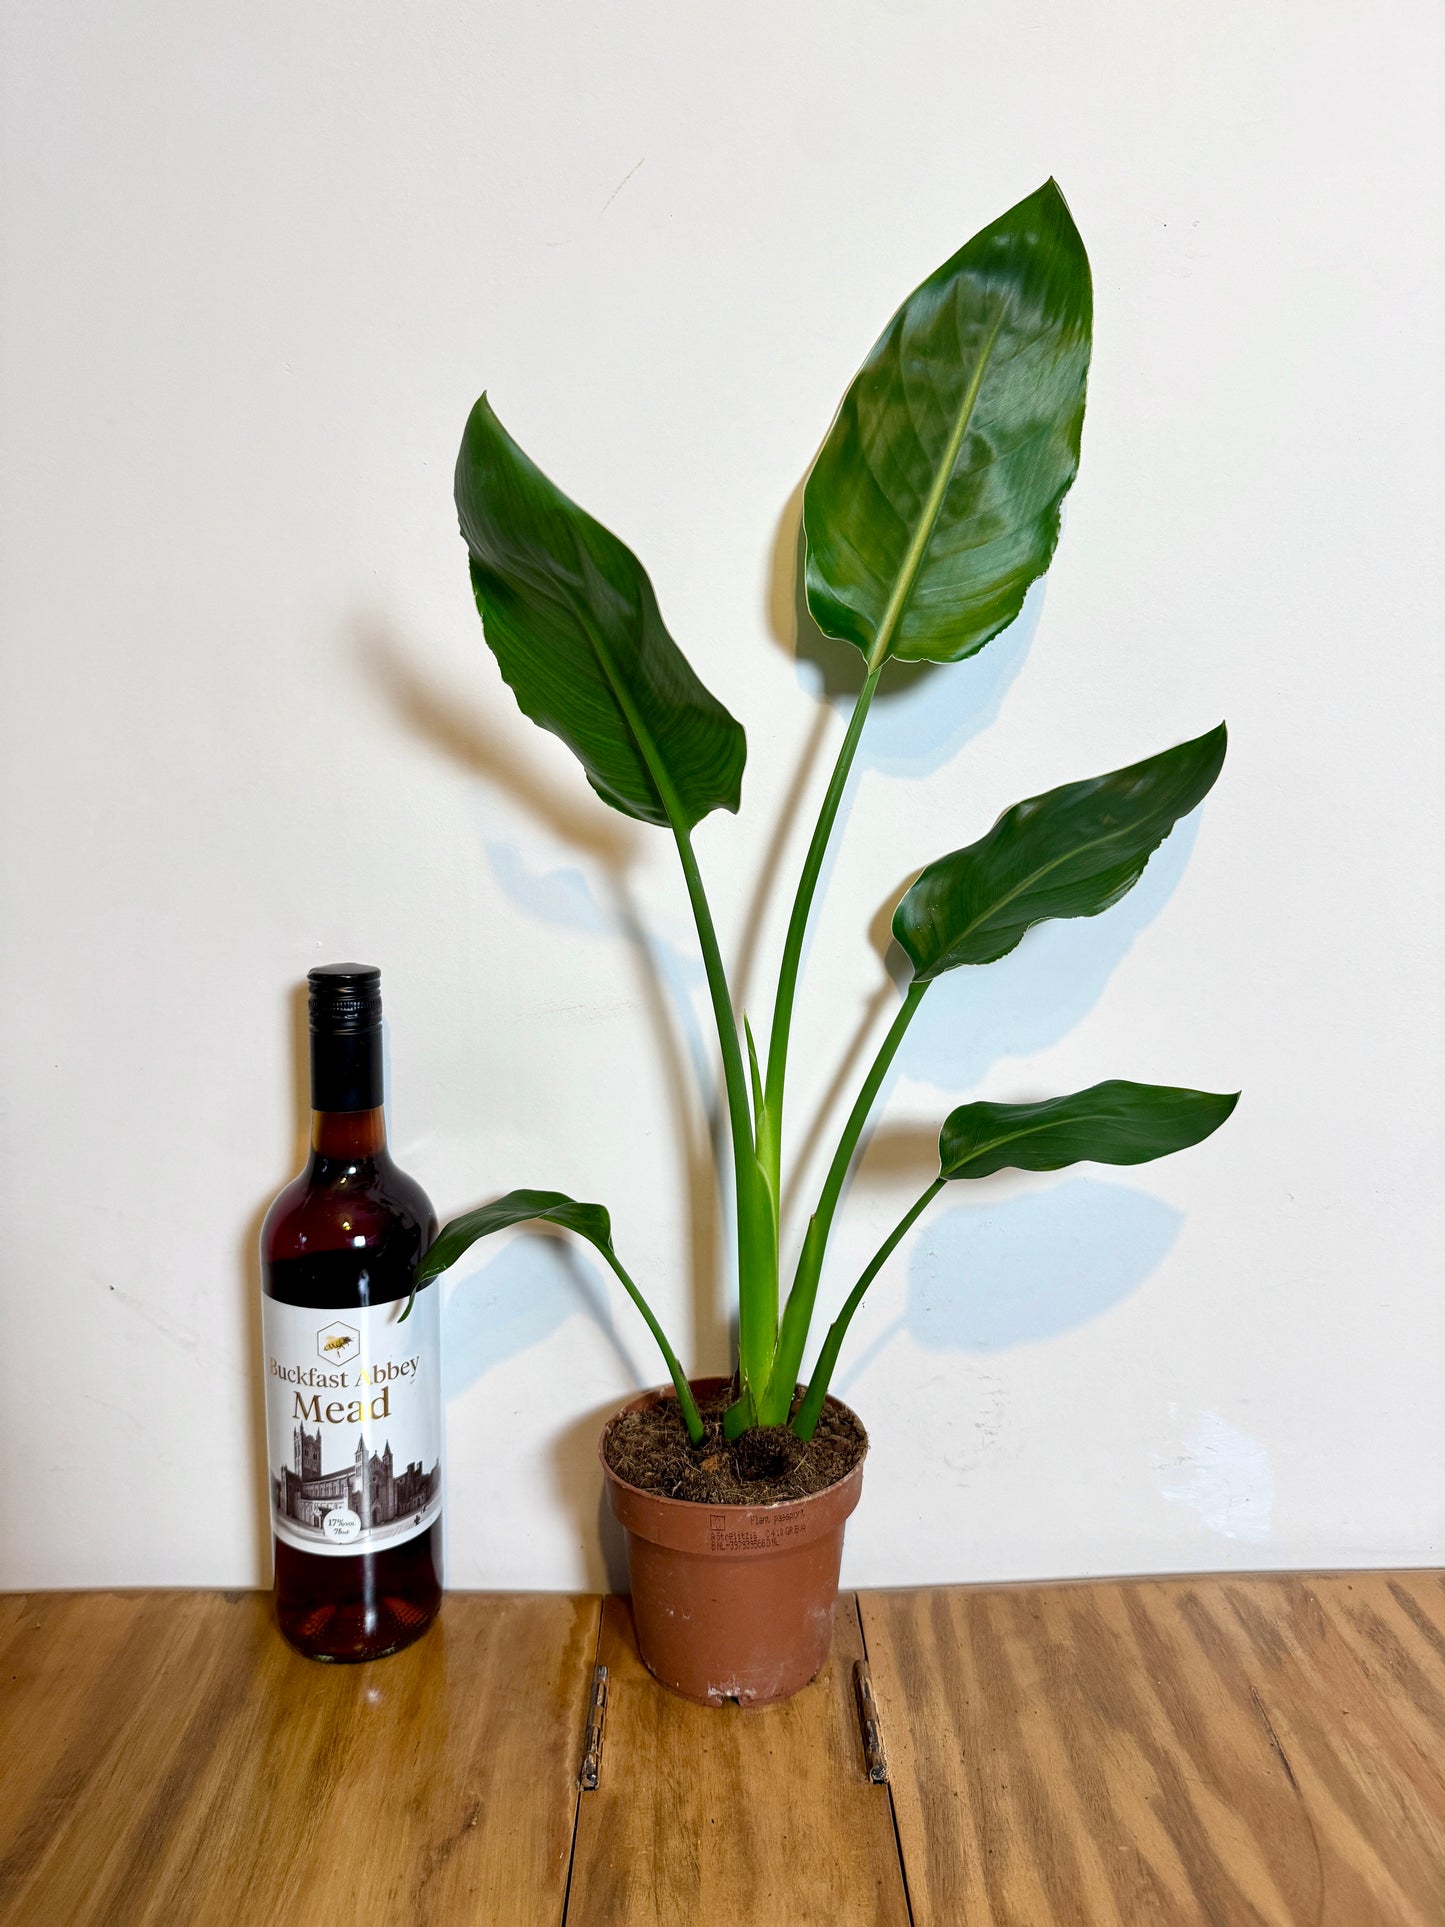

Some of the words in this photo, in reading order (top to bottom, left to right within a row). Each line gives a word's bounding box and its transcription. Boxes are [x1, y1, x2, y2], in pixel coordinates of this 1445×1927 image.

[270, 1357, 349, 1388] Buckfast
[355, 1356, 419, 1386] Abbey
[292, 1386, 393, 1425] Mead
[750, 1515, 770, 1525] Plant
[774, 1509, 806, 1525] passport
